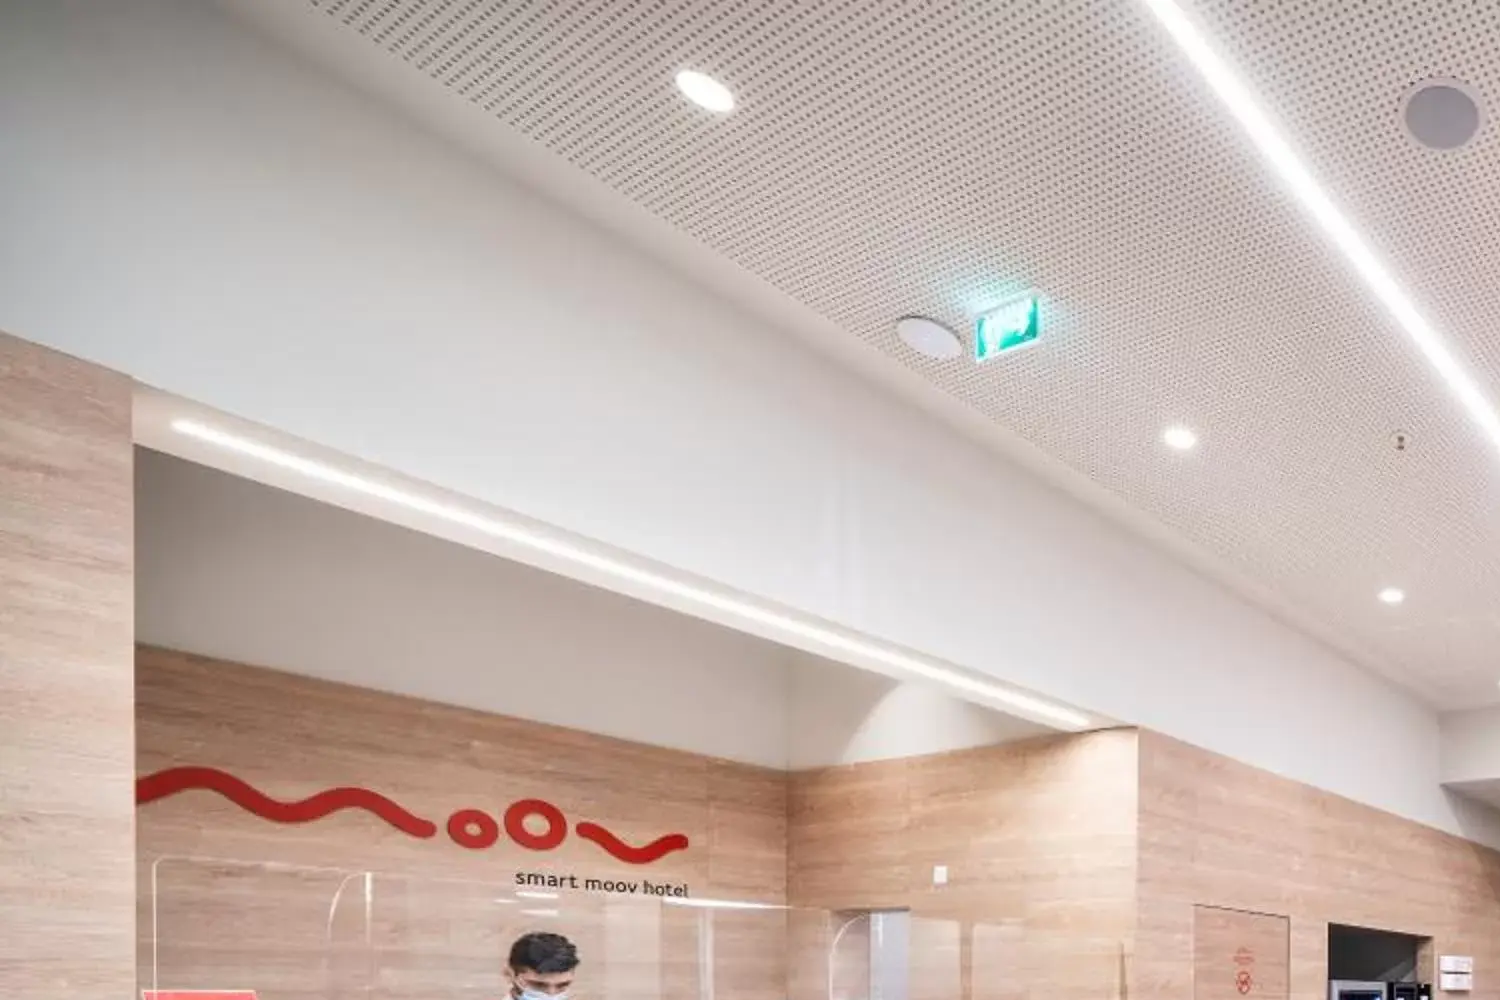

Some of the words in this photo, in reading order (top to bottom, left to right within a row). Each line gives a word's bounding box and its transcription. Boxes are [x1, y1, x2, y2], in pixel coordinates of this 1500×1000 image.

[515, 871, 579, 889] smart
[585, 878, 638, 894] moov
[643, 879, 689, 898] hotel
